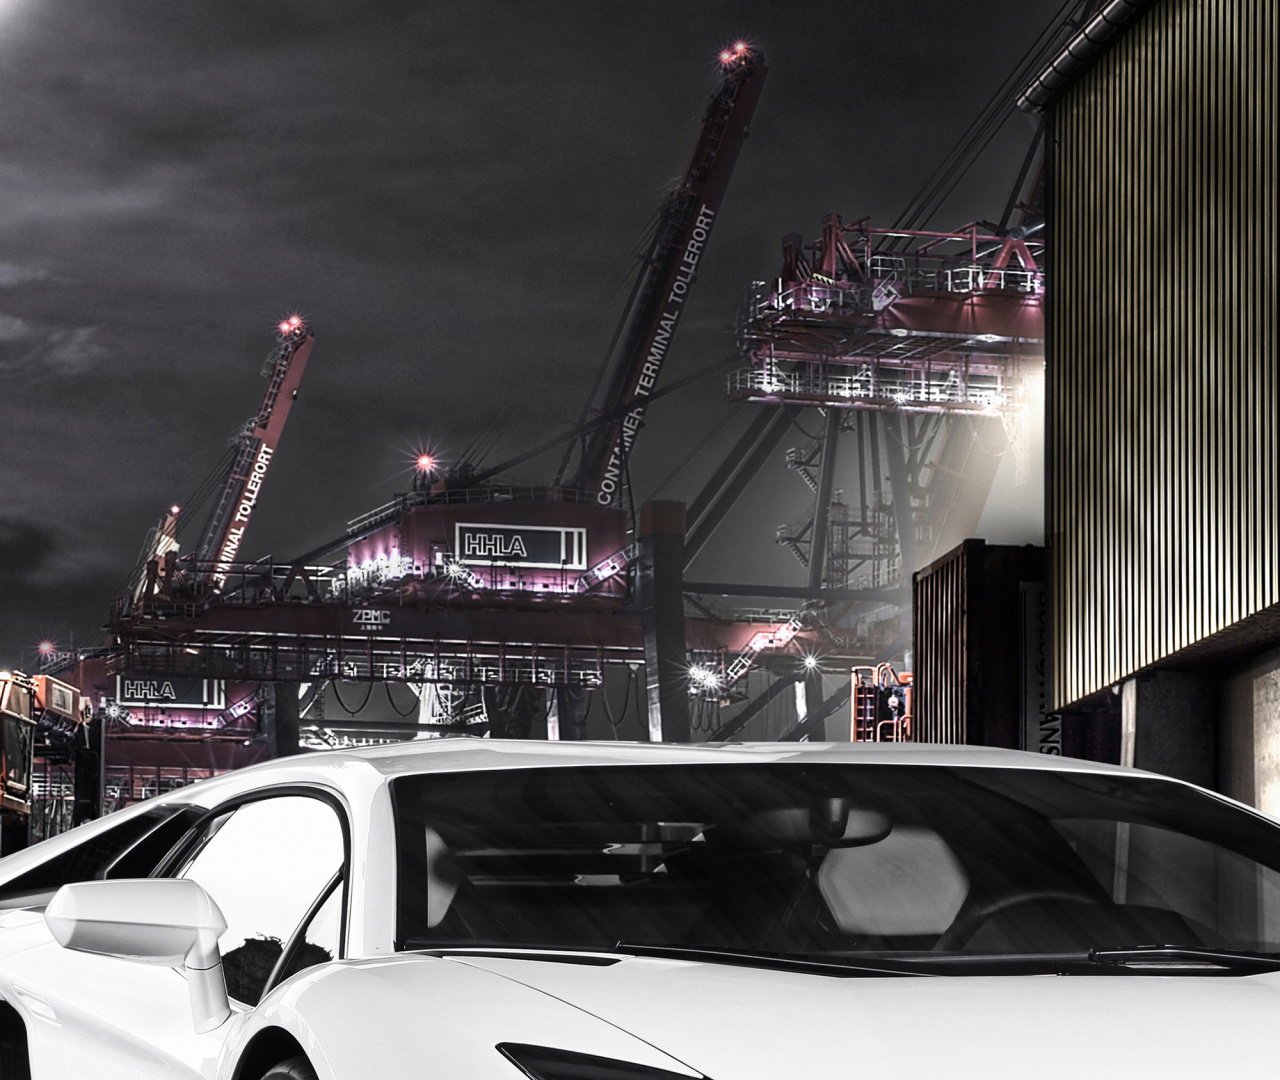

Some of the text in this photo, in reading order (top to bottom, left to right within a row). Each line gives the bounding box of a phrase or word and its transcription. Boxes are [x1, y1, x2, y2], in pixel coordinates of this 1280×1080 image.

[597, 204, 715, 505] CONTNER TERMINAL TOLLERORT
[235, 443, 274, 522] TOLLERORT
[465, 533, 527, 557] HHLA
[353, 610, 390, 623] ZPMC
[125, 680, 177, 700] HHLA
